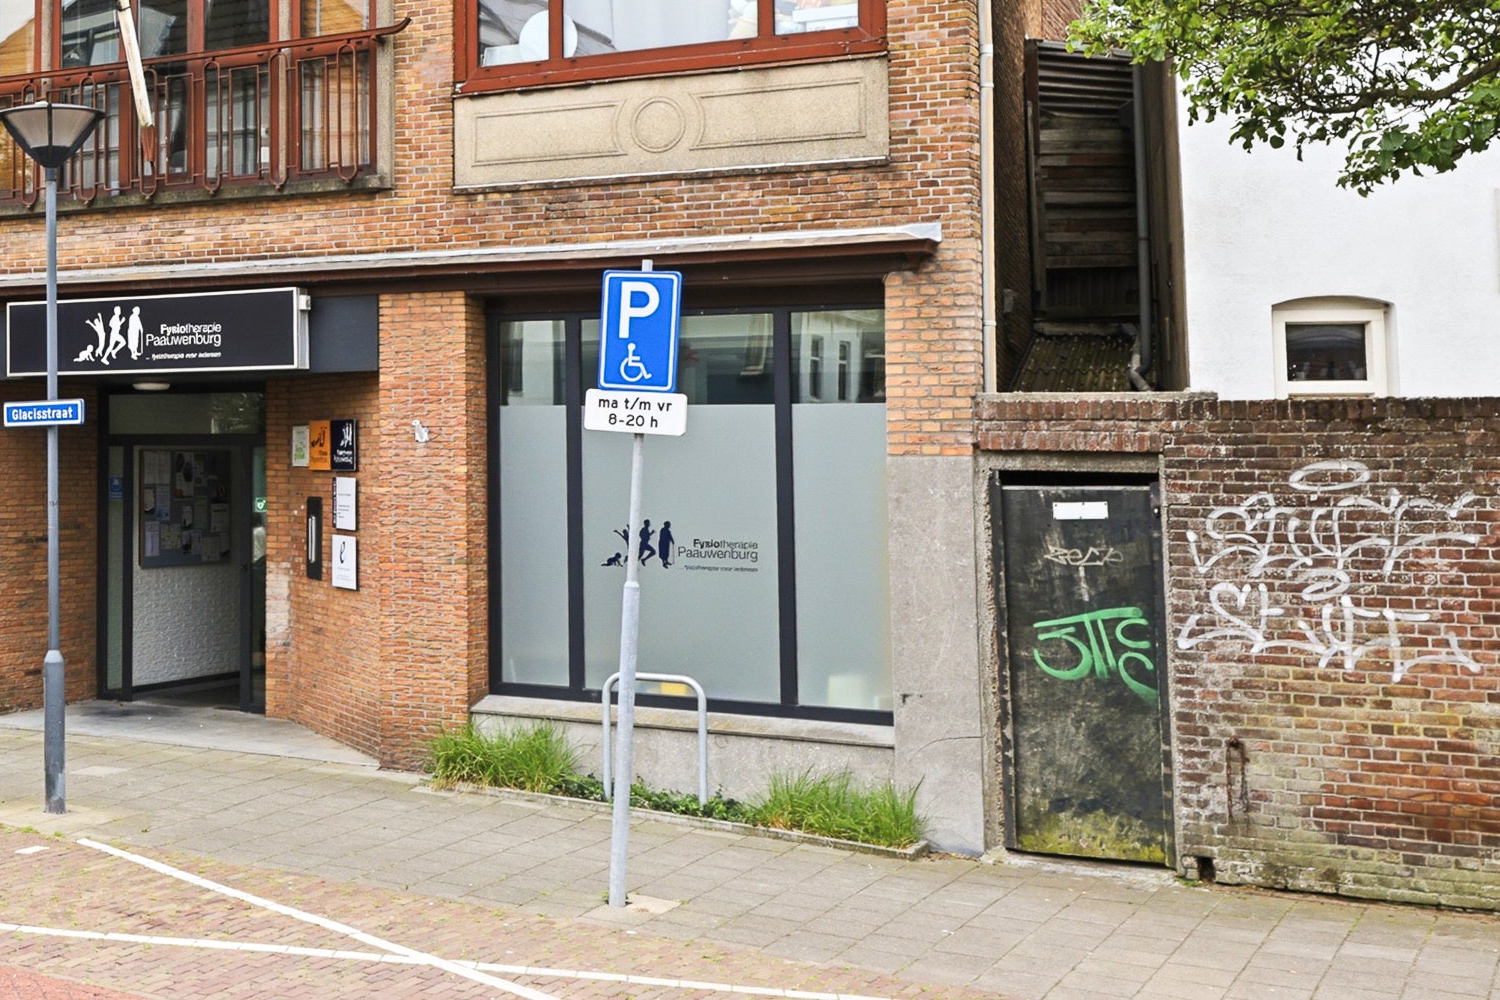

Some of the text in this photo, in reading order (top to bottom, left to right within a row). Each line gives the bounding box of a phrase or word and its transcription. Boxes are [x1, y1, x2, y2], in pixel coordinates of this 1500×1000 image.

[619, 281, 660, 338] P
[160, 323, 222, 336] Fysiotherapie
[146, 332, 222, 347] Paauwenburg
[598, 397, 672, 412] ma t/m vr
[11, 406, 73, 421] Glacisstraat
[608, 414, 658, 428] 8-20 h
[693, 538, 758, 550] Fysiotherapie
[677, 546, 758, 563] Paauwenburg
